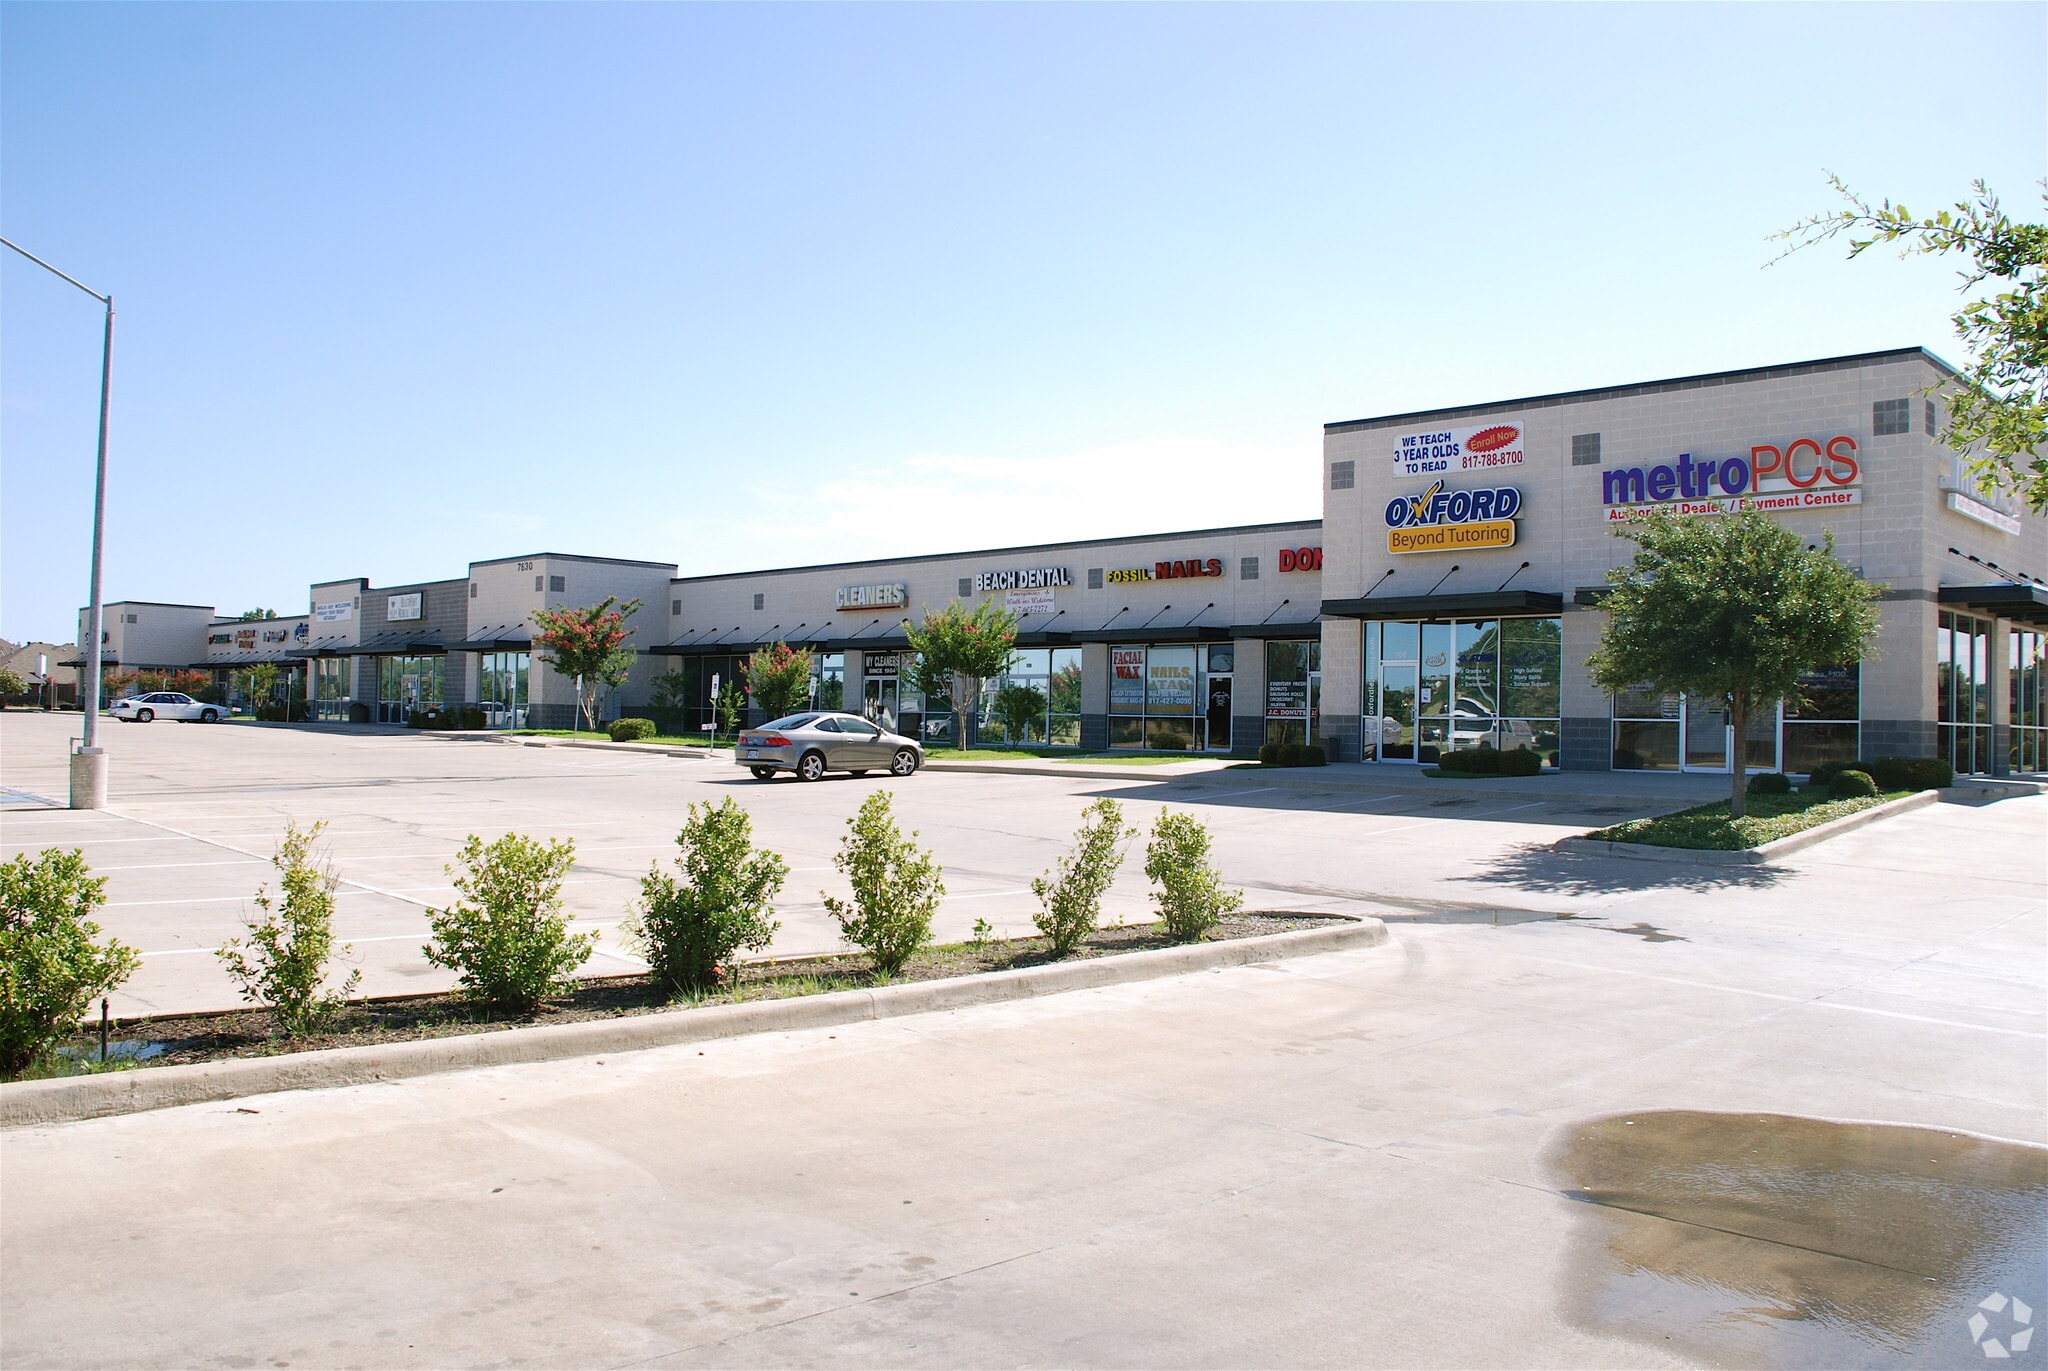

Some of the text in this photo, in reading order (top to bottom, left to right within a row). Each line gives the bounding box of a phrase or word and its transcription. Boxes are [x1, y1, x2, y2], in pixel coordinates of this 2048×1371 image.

[1402, 432, 1451, 447] WE TEACH
[1470, 430, 1516, 450] Enroll Now
[1394, 443, 1459, 462] 3 YEAR OLDS
[1462, 450, 1523, 469] 817-788-8700
[1406, 460, 1447, 473] TO READ
[1602, 435, 1860, 505] metroPCS
[1385, 482, 1519, 527] OXFORD
[1682, 501, 1726, 514] Deale
[1730, 500, 1736, 511] /
[1804, 491, 1853, 506] Center
[1392, 526, 1510, 549] Beyond Tutoring
[517, 561, 533, 572] 7630
[1106, 558, 1221, 583] FOSSIL NAILS
[976, 567, 1068, 591] BEACH DENTAL
[836, 583, 905, 608] CLEANERS
[874, 655, 900, 667] CLEANERS
[1113, 651, 1143, 664] FACIAL
[1115, 666, 1140, 679] WAX
[1150, 666, 1190, 678] NAILS
